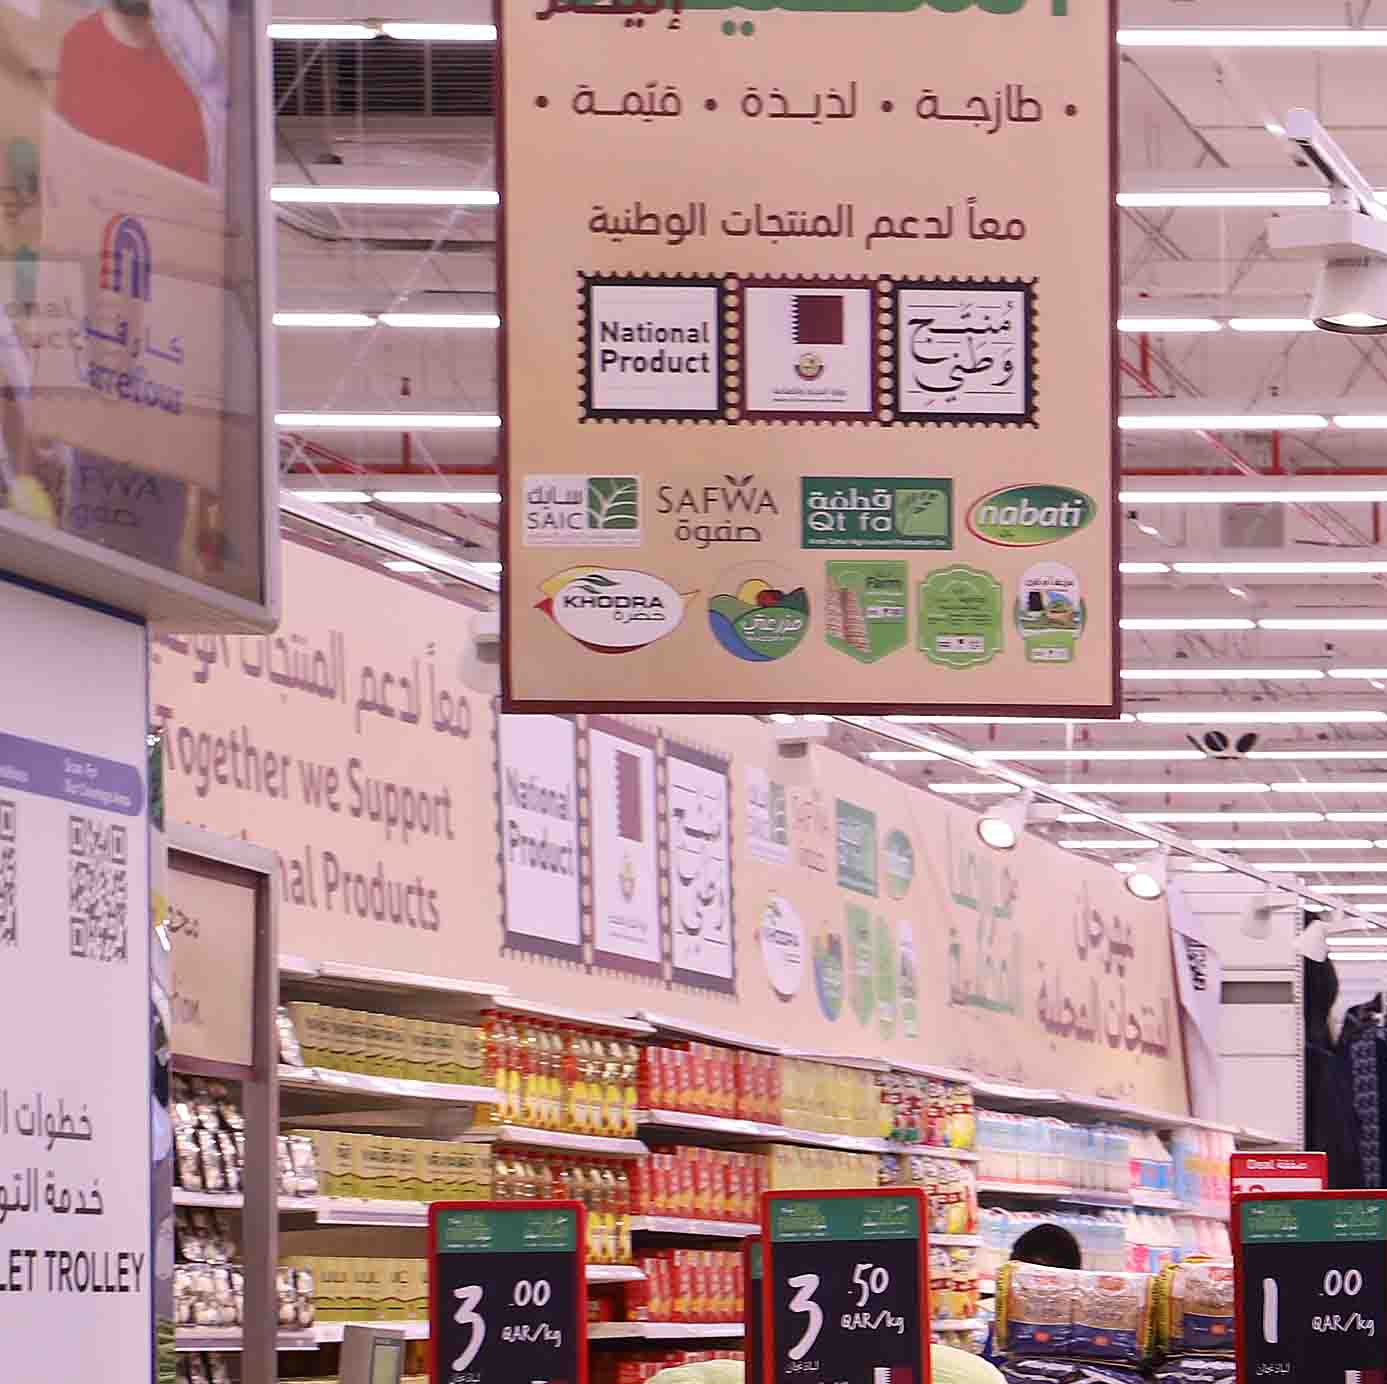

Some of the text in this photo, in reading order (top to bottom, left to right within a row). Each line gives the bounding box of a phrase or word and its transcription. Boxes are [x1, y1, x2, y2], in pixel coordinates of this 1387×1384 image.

[741, 81, 856, 124] لذيذة
[916, 84, 1042, 134] طازجة
[589, 202, 706, 245] الوطنية
[721, 204, 853, 244] المنتجات
[866, 206, 952, 250] لدعم
[600, 322, 709, 343] National
[601, 349, 710, 373] Product
[655, 484, 779, 515] SAFWA
[978, 498, 1084, 529] nabati
[675, 520, 761, 549] صفوة
[153, 704, 289, 798] Together
[299, 757, 341, 813] we
[347, 756, 454, 844] Support
[506, 766, 573, 822] National
[507, 821, 575, 878] Product
[323, 850, 441, 933] Products
[44, 1250, 144, 1292] TROLLEY
[452, 1285, 485, 1371] 3
[788, 1274, 823, 1360] 3
